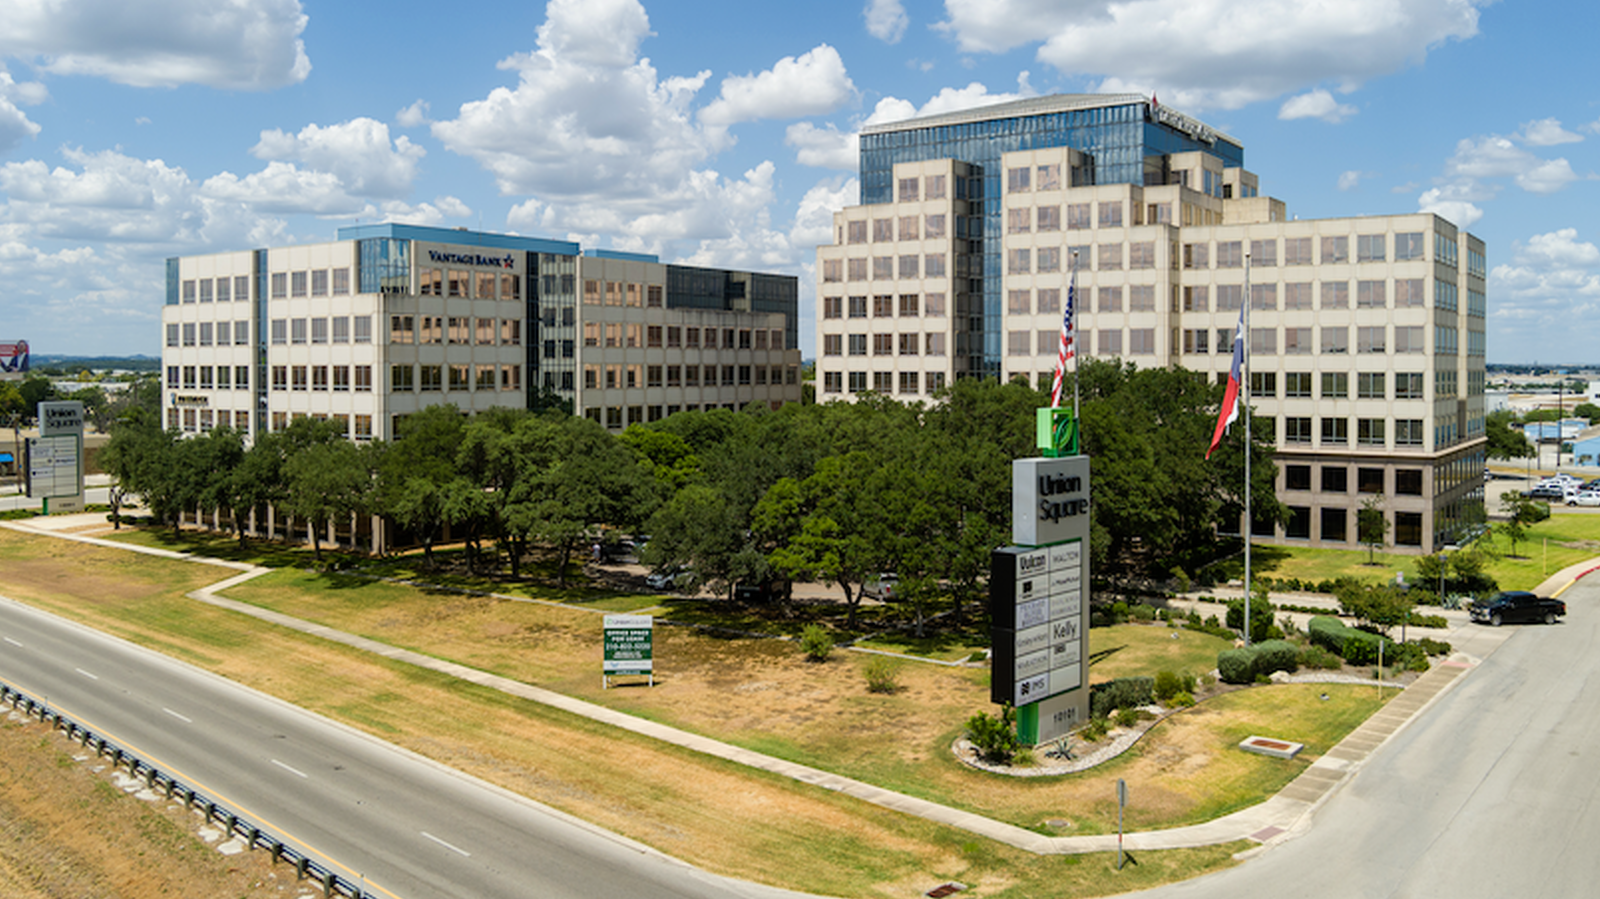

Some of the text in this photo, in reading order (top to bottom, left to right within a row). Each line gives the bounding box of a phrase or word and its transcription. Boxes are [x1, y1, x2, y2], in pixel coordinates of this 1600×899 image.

[429, 250, 502, 267] VANTAGE BANK
[46, 408, 77, 419] Union
[46, 419, 81, 430] Square
[1039, 473, 1081, 496] Union
[1039, 497, 1089, 524] Square
[1020, 554, 1046, 570] Vulcan
[1053, 621, 1077, 639] Kelly
